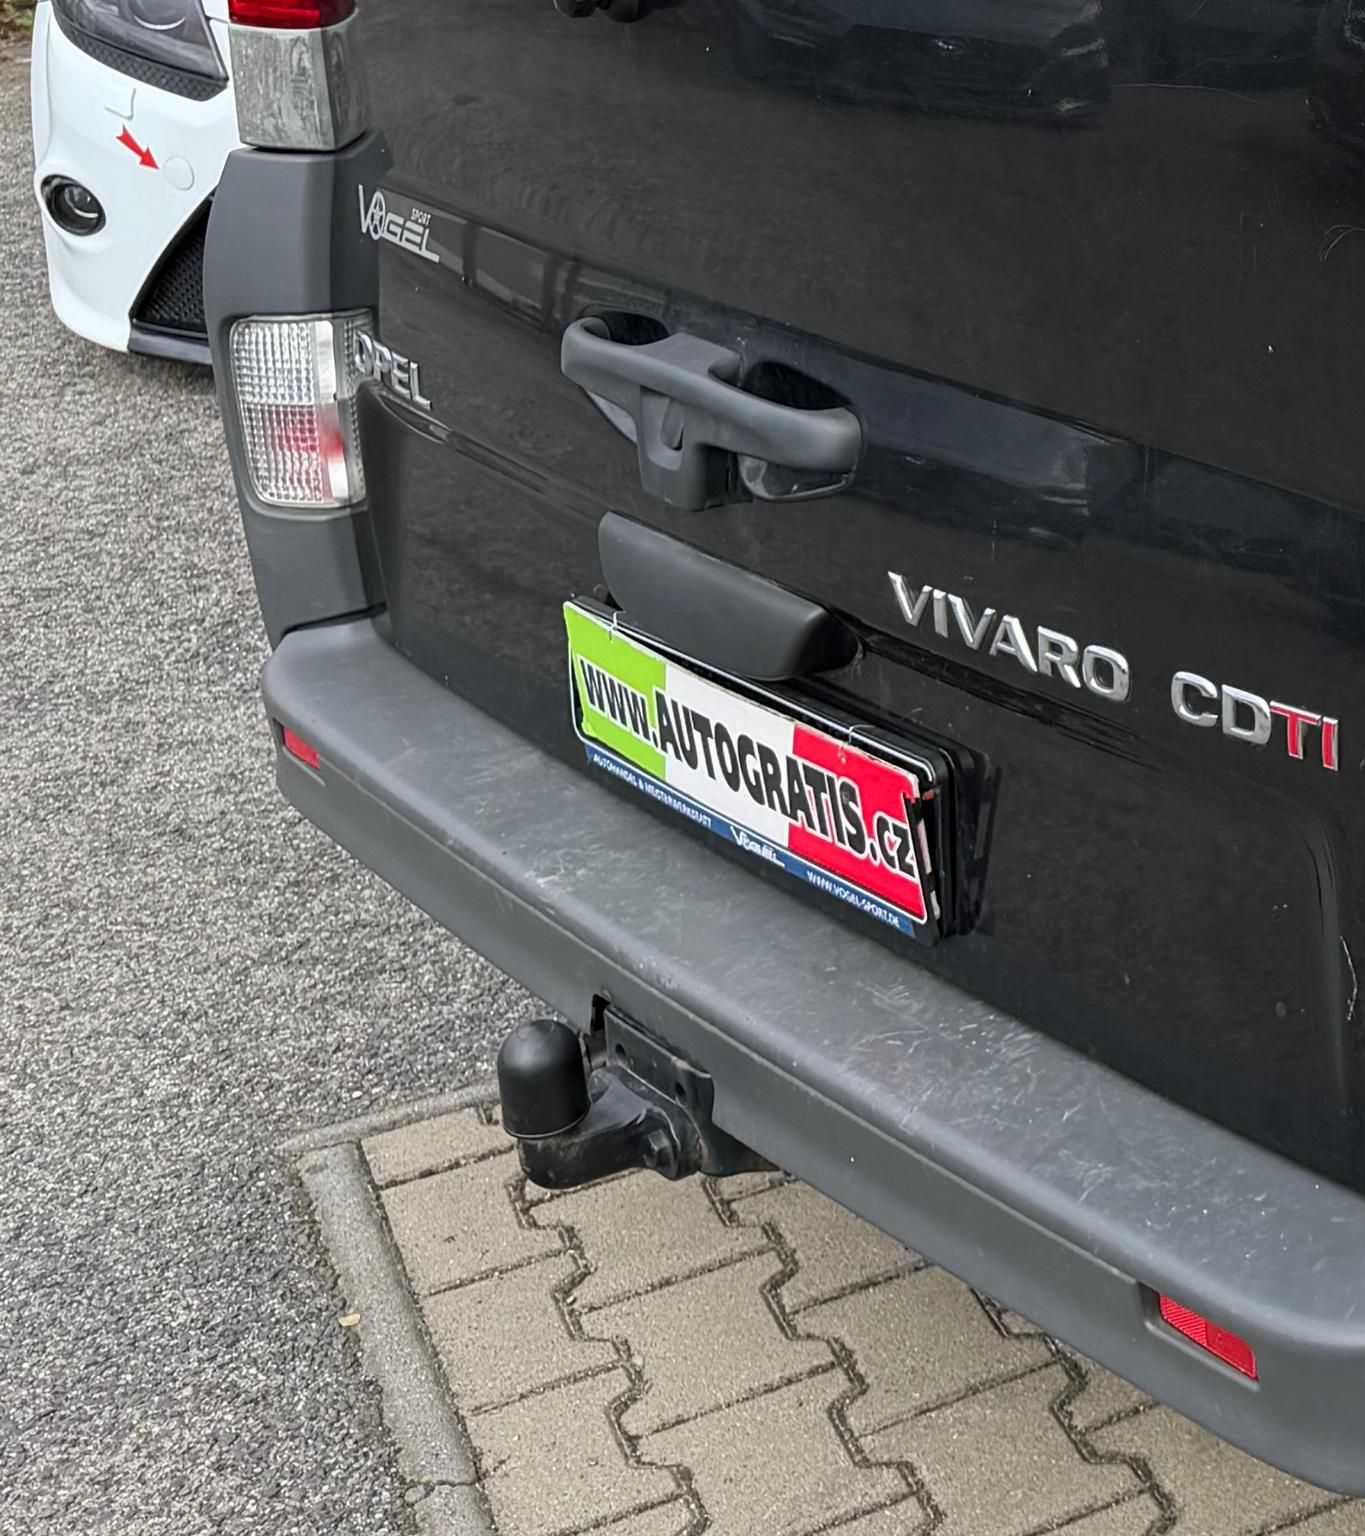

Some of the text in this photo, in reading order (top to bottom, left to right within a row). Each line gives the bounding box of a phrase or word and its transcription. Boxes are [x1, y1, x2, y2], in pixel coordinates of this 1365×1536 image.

[358, 183, 440, 264] VOGEL
[411, 207, 432, 226] SPORT
[353, 329, 433, 412] OPEL
[888, 571, 1339, 772] VIVARO CDTI
